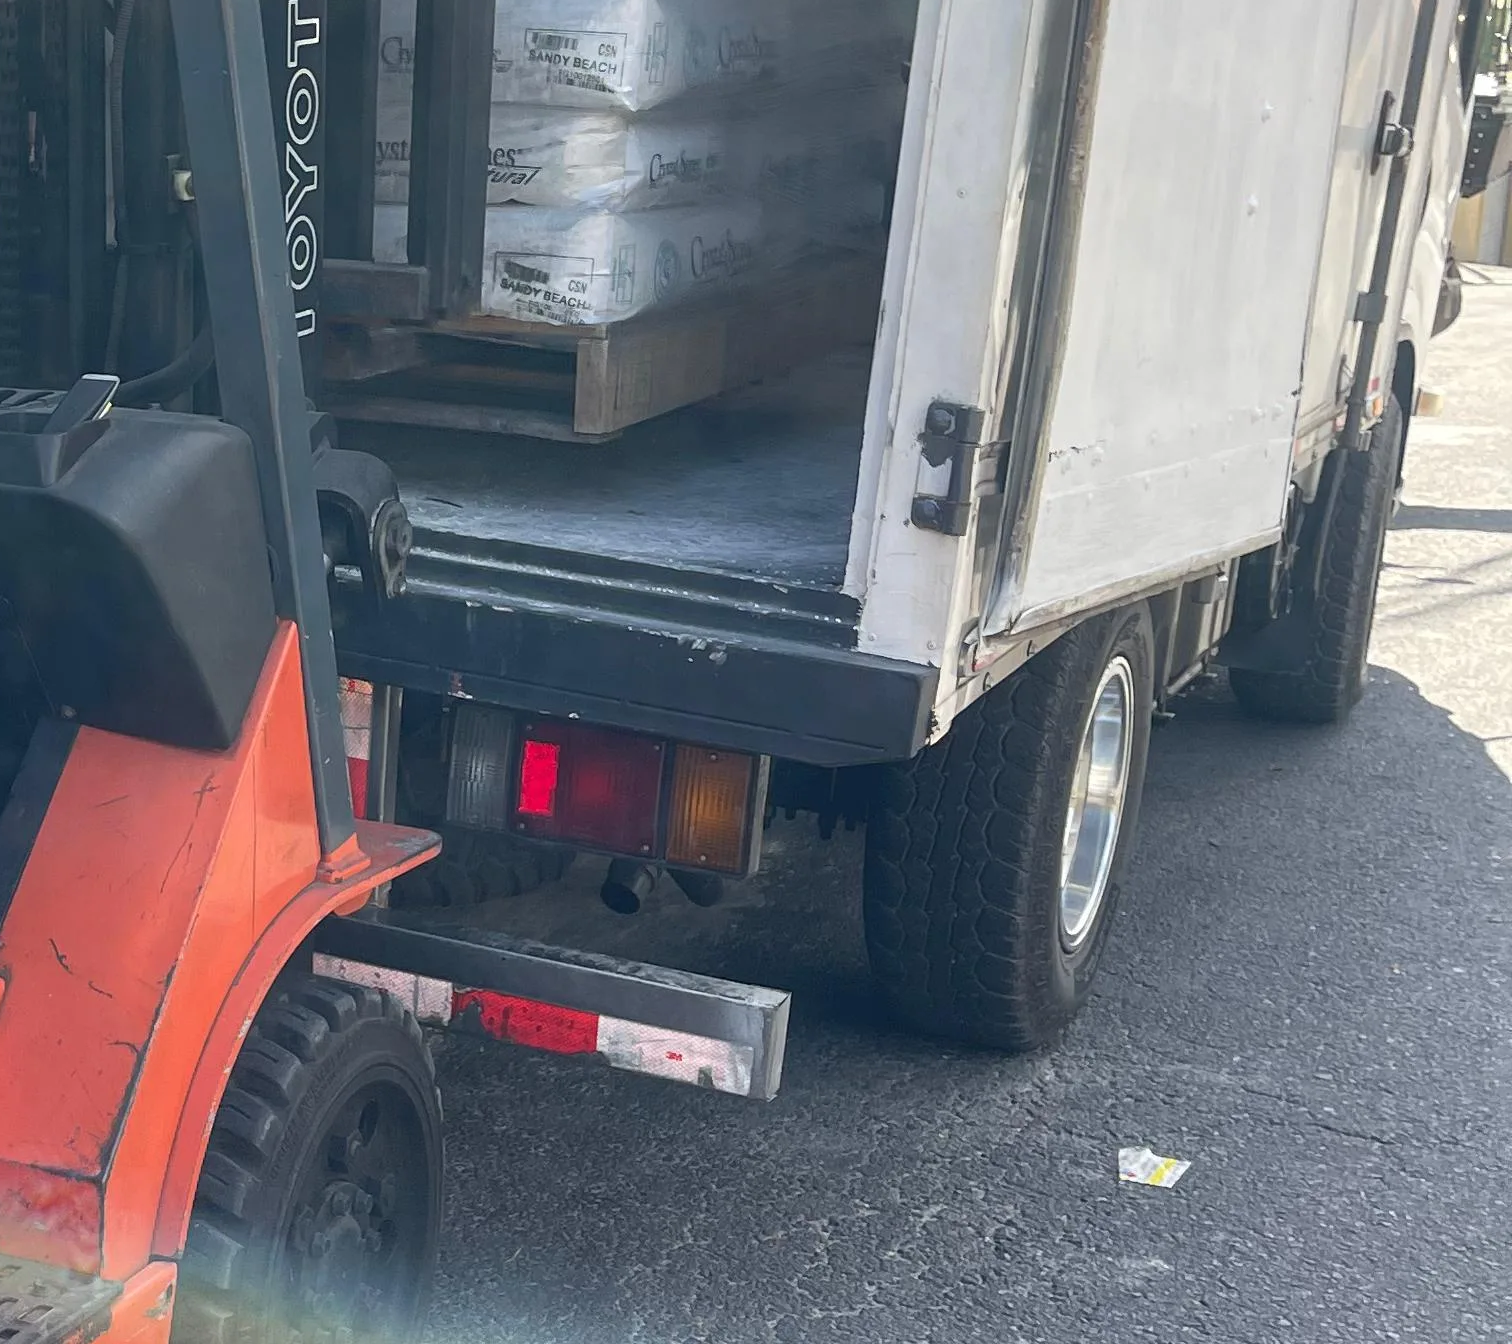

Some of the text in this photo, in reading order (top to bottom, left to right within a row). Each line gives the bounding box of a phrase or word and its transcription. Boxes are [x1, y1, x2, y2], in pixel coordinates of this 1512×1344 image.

[598, 43, 617, 58] CSN
[528, 48, 571, 67] SANDY
[572, 56, 617, 75] BEACH
[499, 277, 586, 309] SANDY BEACH
[567, 279, 588, 294] CSN
